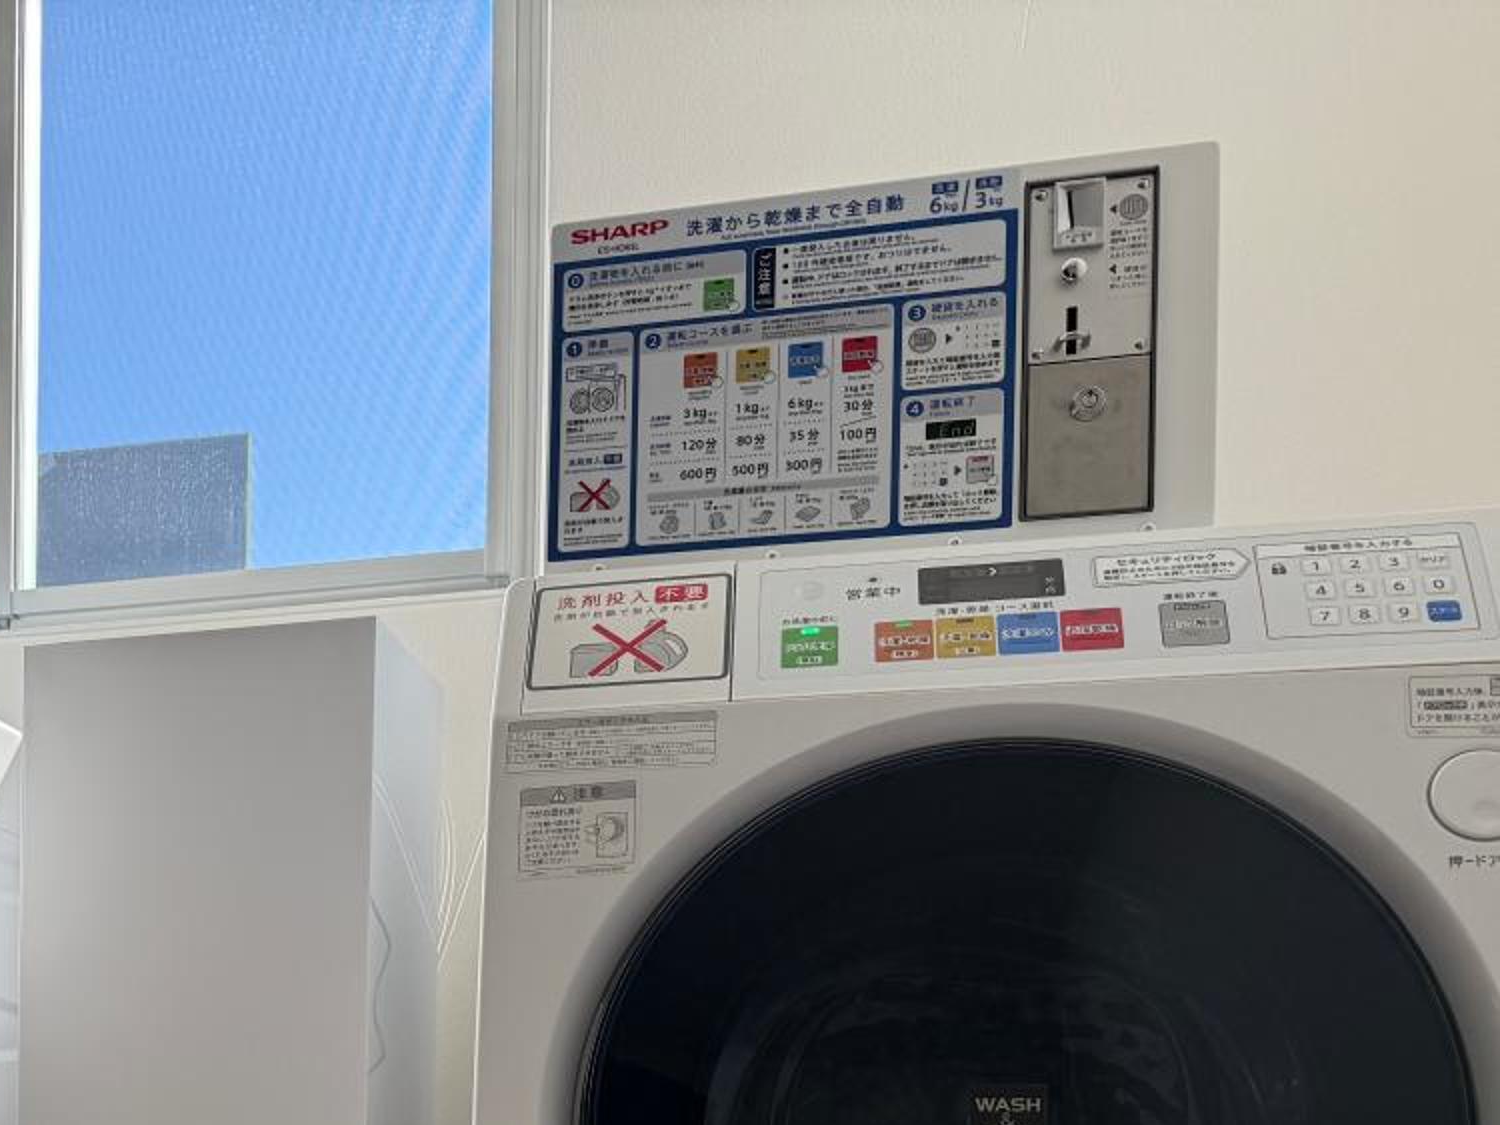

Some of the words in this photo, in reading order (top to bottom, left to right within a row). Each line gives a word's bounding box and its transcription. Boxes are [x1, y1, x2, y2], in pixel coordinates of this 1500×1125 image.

[686, 193, 904, 237] 洗濯から乾燥まで全自動
[571, 219, 669, 245] SHARP
[839, 428, 877, 442] 100円
[682, 438, 717, 451] 120分
[680, 468, 716, 482] 600円
[732, 463, 768, 478] 500円
[1312, 560, 1319, 571] 1
[1350, 559, 1360, 569] 2
[1389, 557, 1399, 567] 3
[1355, 583, 1365, 593] 5
[1394, 581, 1404, 591] 6
[1433, 579, 1444, 589] 0
[845, 587, 901, 601] 営業中
[1316, 585, 1326, 595] 4
[557, 591, 649, 611] 洗剤投入
[659, 585, 707, 602] 不要
[1320, 611, 1330, 621] 7
[1359, 608, 1370, 619] 8
[1398, 607, 1409, 618] 9
[975, 1097, 1041, 1113] WASH
